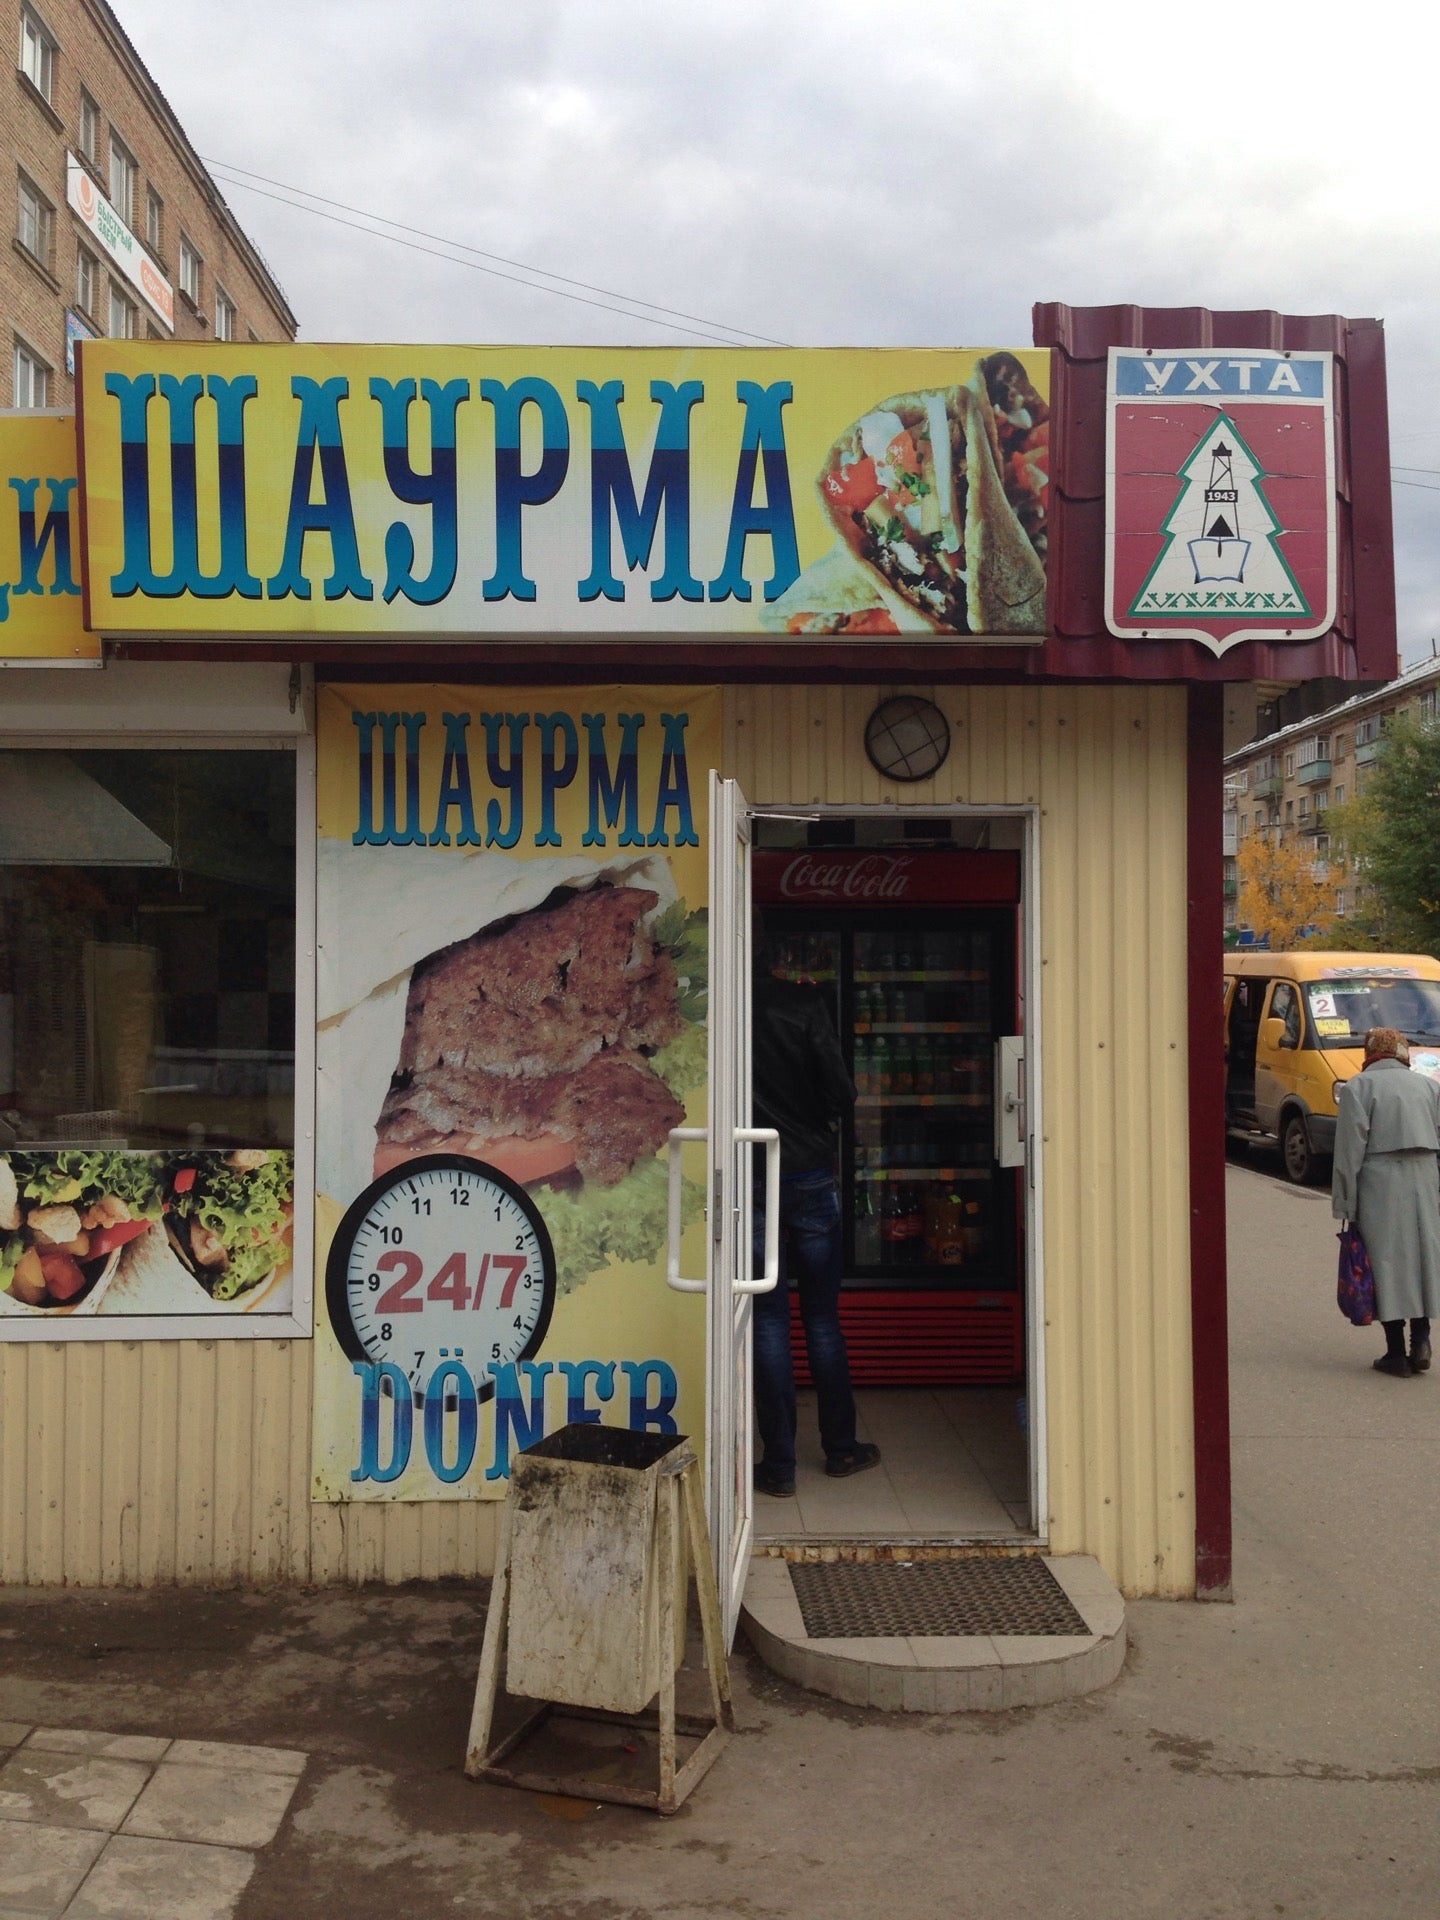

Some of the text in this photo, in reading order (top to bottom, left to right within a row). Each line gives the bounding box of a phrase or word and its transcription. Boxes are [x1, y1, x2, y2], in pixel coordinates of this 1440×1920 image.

[97, 201, 133, 254] БЫСТРЫЙ
[1143, 361, 1302, 393] УХТА
[105, 373, 802, 604] ШАУРМА
[1207, 491, 1237, 502] 1943
[0, 477, 82, 623] И
[352, 711, 700, 849] ШАУРМА
[780, 854, 914, 898] Coca-Cola
[1316, 999, 1330, 1013] 2
[411, 1197, 432, 1217] 11
[450, 1188, 470, 1207] 12
[494, 1206, 502, 1222] 1
[379, 1226, 404, 1245] 10
[515, 1235, 525, 1251] 2
[368, 1273, 381, 1292] 9
[374, 1250, 528, 1315] 24/7
[523, 1273, 533, 1289] 3
[380, 1322, 393, 1342] 8
[513, 1314, 522, 1331] 4
[413, 1350, 426, 1370] 7
[491, 1343, 501, 1360] 5
